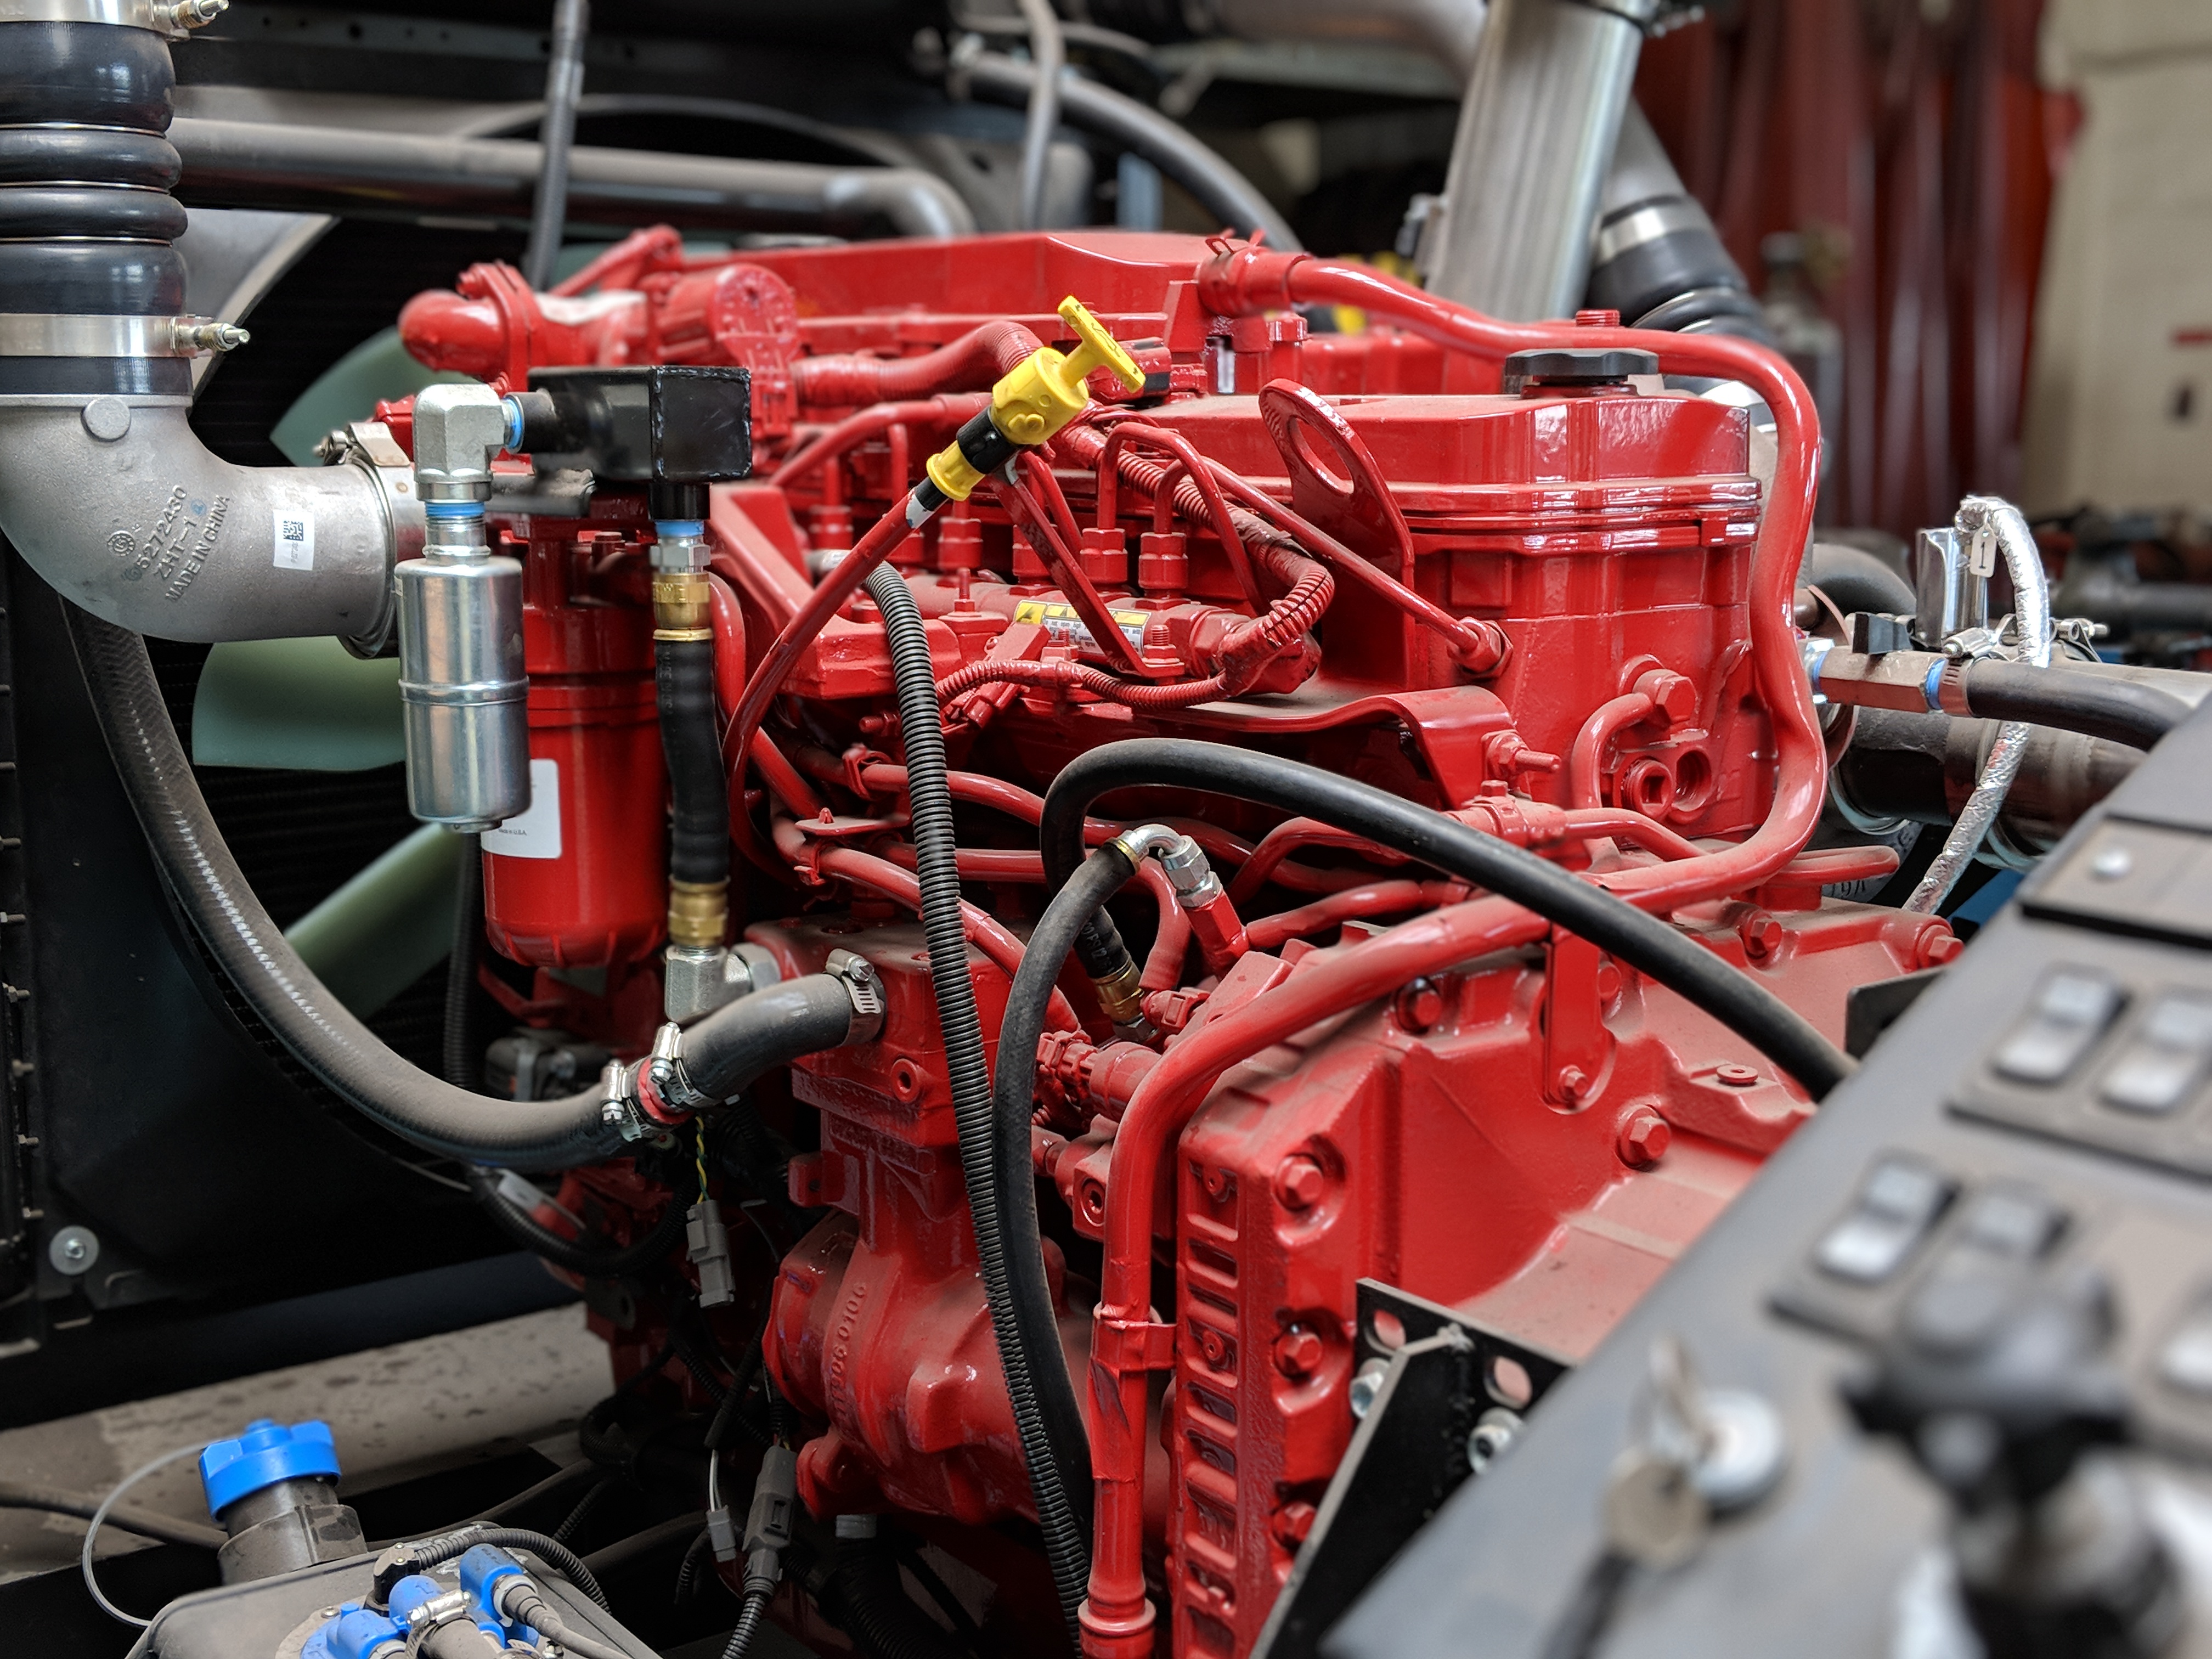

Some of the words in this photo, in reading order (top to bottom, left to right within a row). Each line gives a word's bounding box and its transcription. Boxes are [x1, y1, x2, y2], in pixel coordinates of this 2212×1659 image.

[136, 485, 187, 569] 5272430
[154, 516, 196, 580] ZHT-1
[165, 560, 201, 602] MADE
[192, 540, 211, 562] IN
[203, 495, 229, 541] CHINA
[1978, 541, 1986, 569] 1
